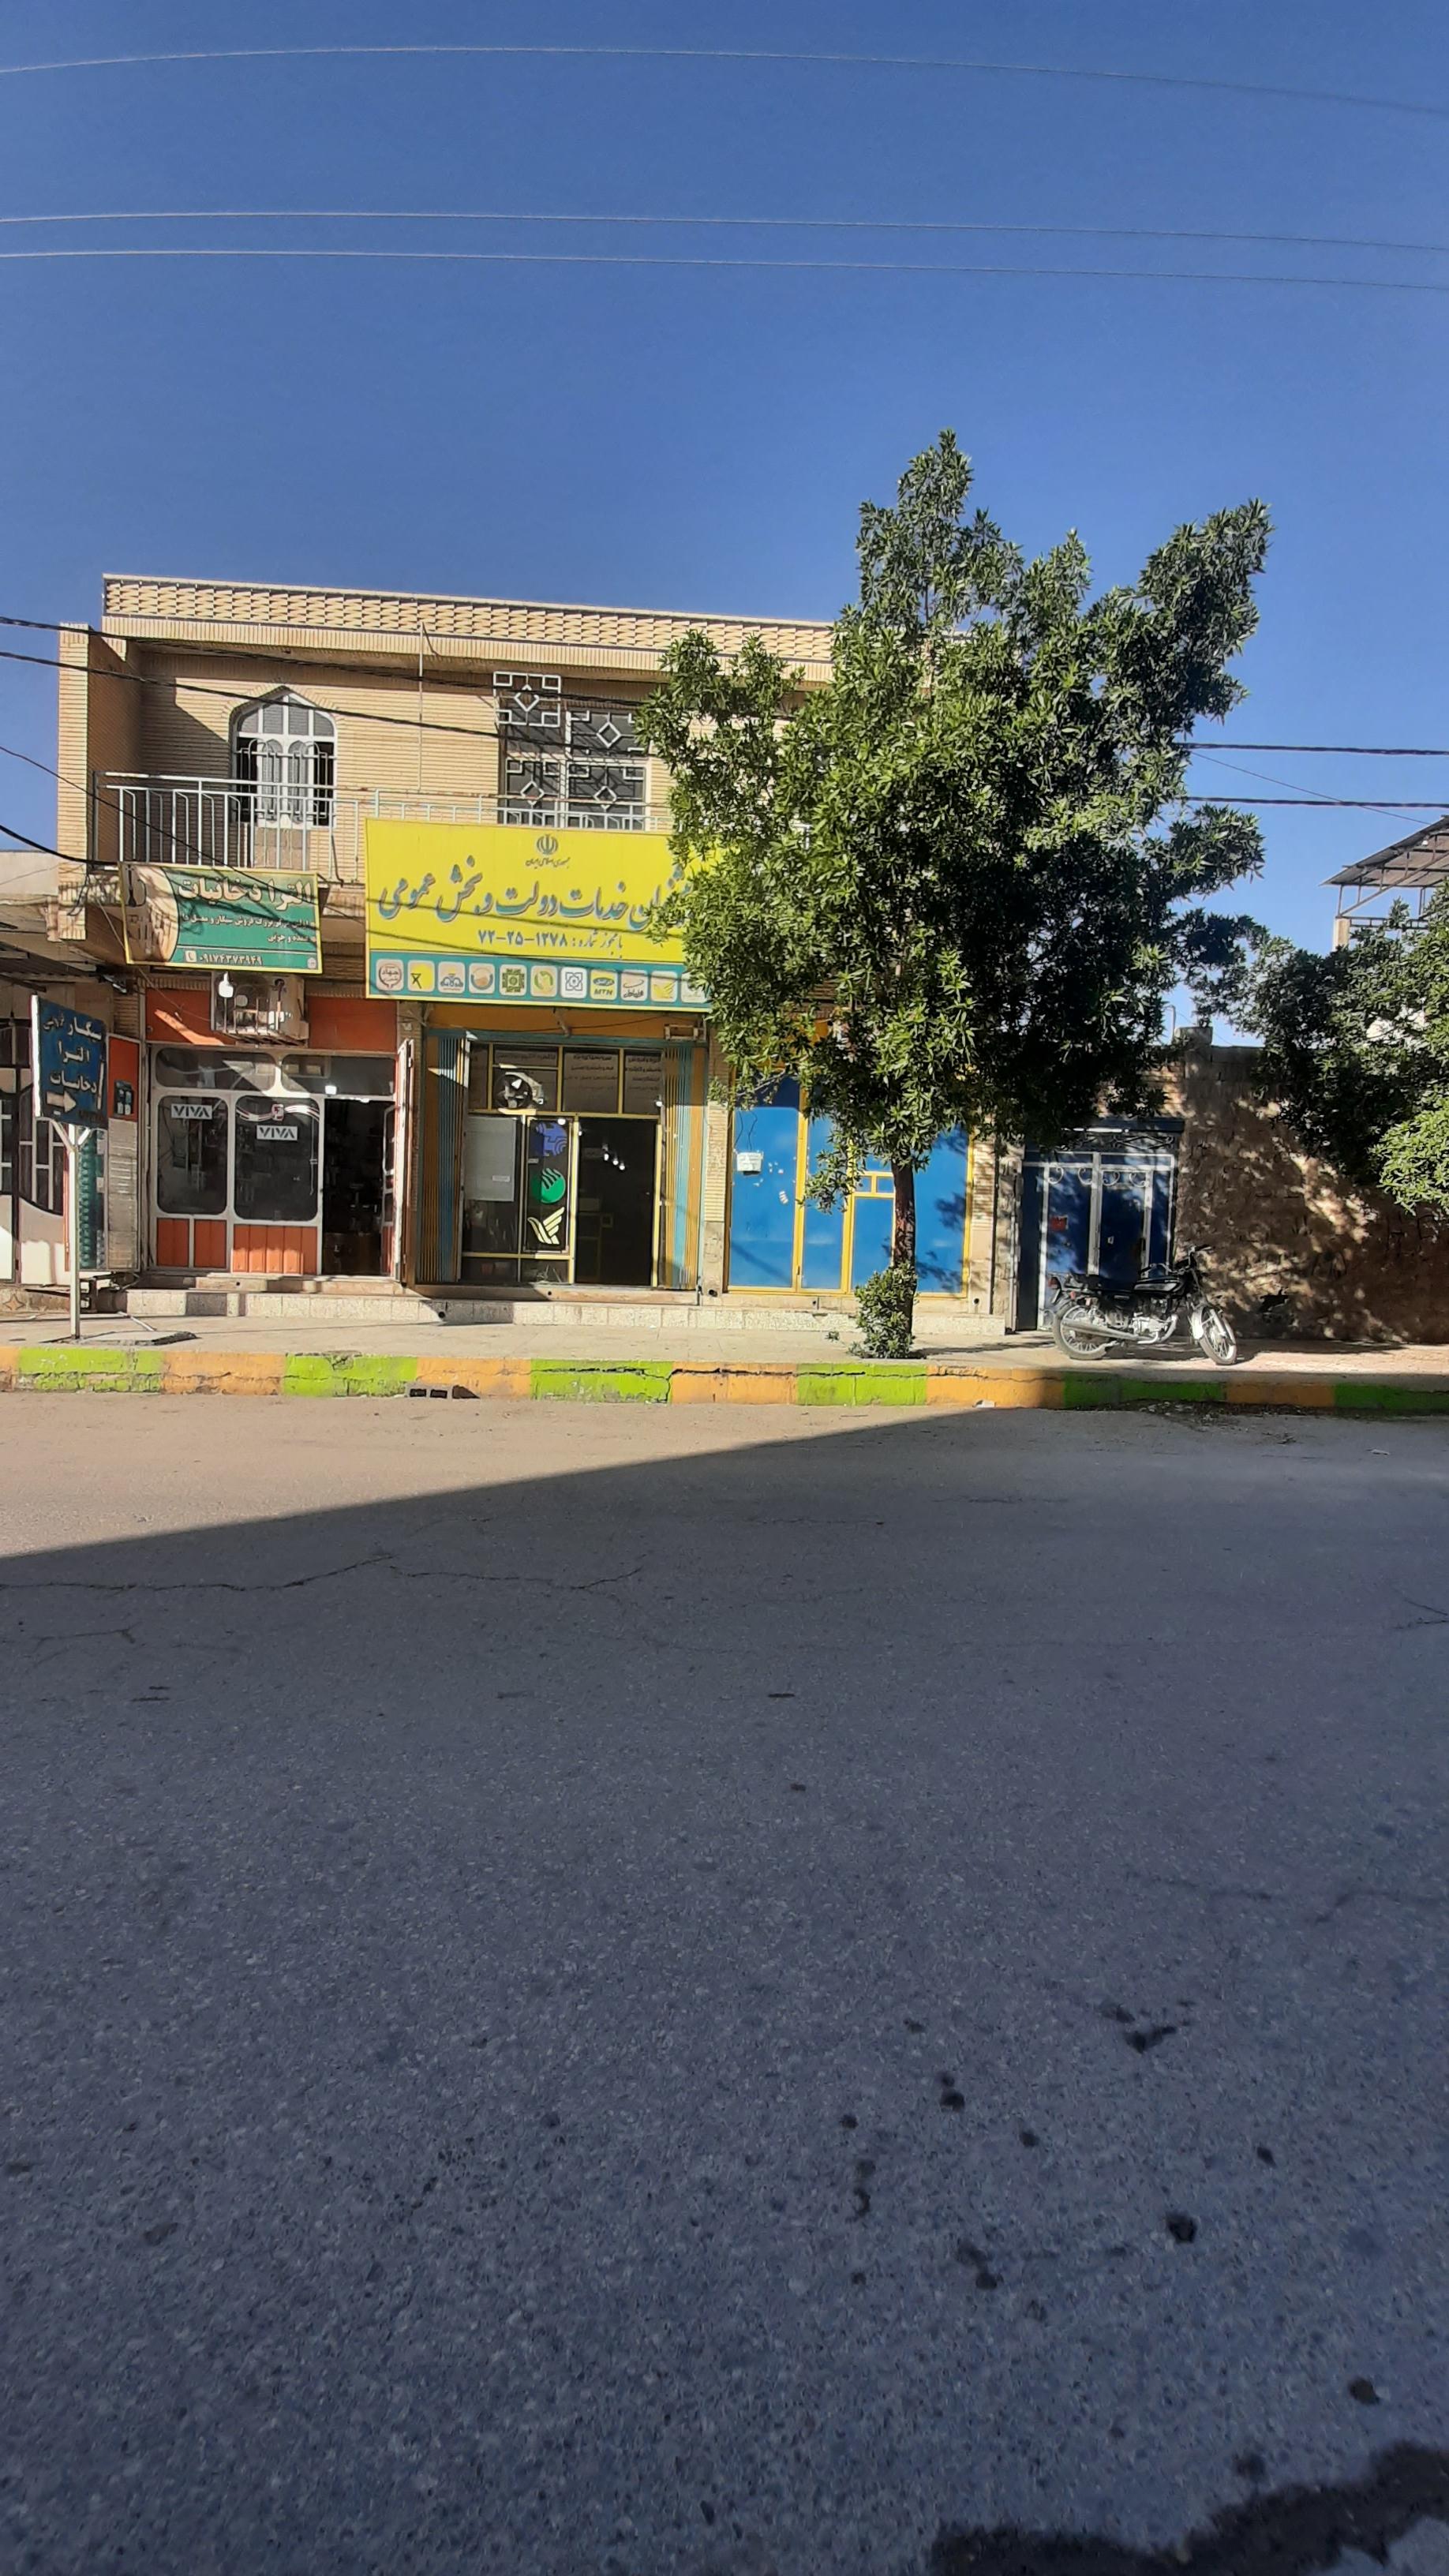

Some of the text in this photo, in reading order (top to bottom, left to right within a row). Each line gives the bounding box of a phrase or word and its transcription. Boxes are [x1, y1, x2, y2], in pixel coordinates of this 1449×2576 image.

[178, 877, 311, 911] الترا دخانیات
[378, 872, 436, 919] عمومی
[436, 855, 483, 922] بخش
[479, 893, 492, 914] و
[495, 881, 557, 915] دولت
[559, 881, 628, 920] خدمات
[174, 1106, 209, 1118] VIVA
[259, 1126, 294, 1138] VIVA
